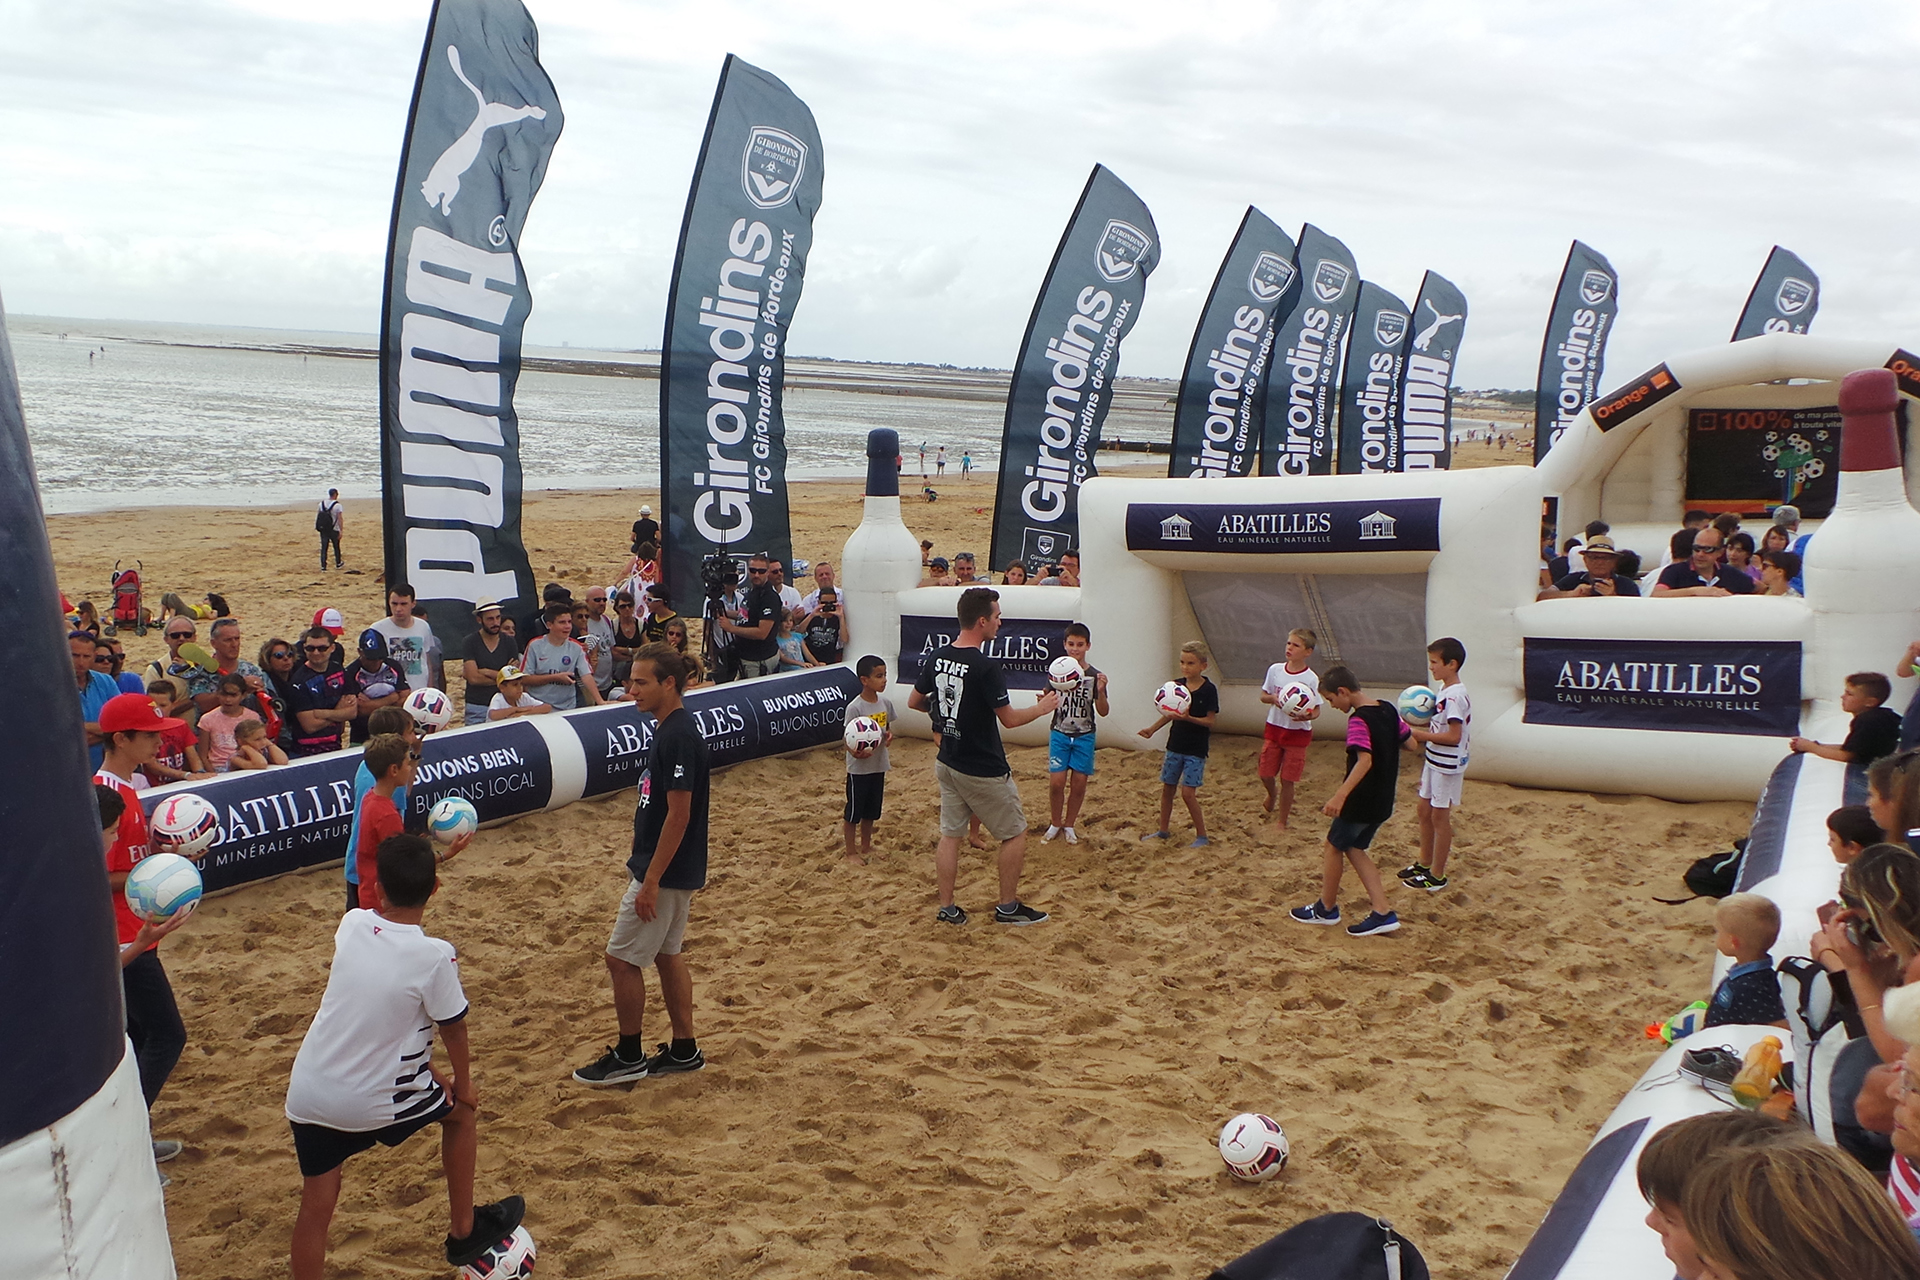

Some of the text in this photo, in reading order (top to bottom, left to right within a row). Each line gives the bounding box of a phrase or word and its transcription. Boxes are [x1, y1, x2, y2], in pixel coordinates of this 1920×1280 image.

[753, 145, 797, 168] DE BORDEAUX
[756, 135, 799, 159] GIRONDINS
[1588, 313, 1608, 357] Bordeaux
[753, 228, 795, 494] FC Girondins de Bordeaux
[693, 217, 773, 544] Girondins
[1073, 299, 1132, 487] FC Girondins de Bordeaux
[1244, 378, 1257, 396] de
[1277, 307, 1330, 477] Girondins
[1313, 313, 1344, 457] FC Girondins de Bordeaux
[400, 225, 518, 602] PUMA
[1021, 285, 1113, 522] Girondins
[1356, 352, 1394, 475] rondins
[1402, 354, 1450, 474] PUMA
[1597, 385, 1650, 419] Orange
[1234, 394, 1253, 452] Girondins
[1721, 411, 1792, 430] 100%
[1231, 454, 1243, 473] FC
[1217, 512, 1331, 534] ABATILLES
[1218, 534, 1331, 544] EAU MINÉRALE NATURELLE
[1030, 553, 1057, 563] Girondins
[920, 633, 1049, 660] ABLLES
[935, 658, 970, 678] STAFF
[1002, 663, 1049, 673] ATURELLE
[1555, 660, 1762, 696] ABATILLES
[763, 685, 847, 714] BUVONS BIEN,
[1060, 707, 1088, 718] WILD
[1062, 697, 1086, 708] AND
[1557, 692, 1760, 711] EAU MINÉRALE NATURELLE
[606, 704, 745, 758] ABALES
[770, 707, 844, 736] BUVONS LOC
[708, 736, 746, 751] TURELLE
[413, 746, 524, 786] BUVONS BIEN,
[607, 760, 629, 774] EAU
[415, 771, 535, 814] BUVONS LOCAL
[210, 779, 354, 848] ATILLE
[216, 836, 293, 867] MINÉRALE
[300, 823, 350, 845] NATUR
